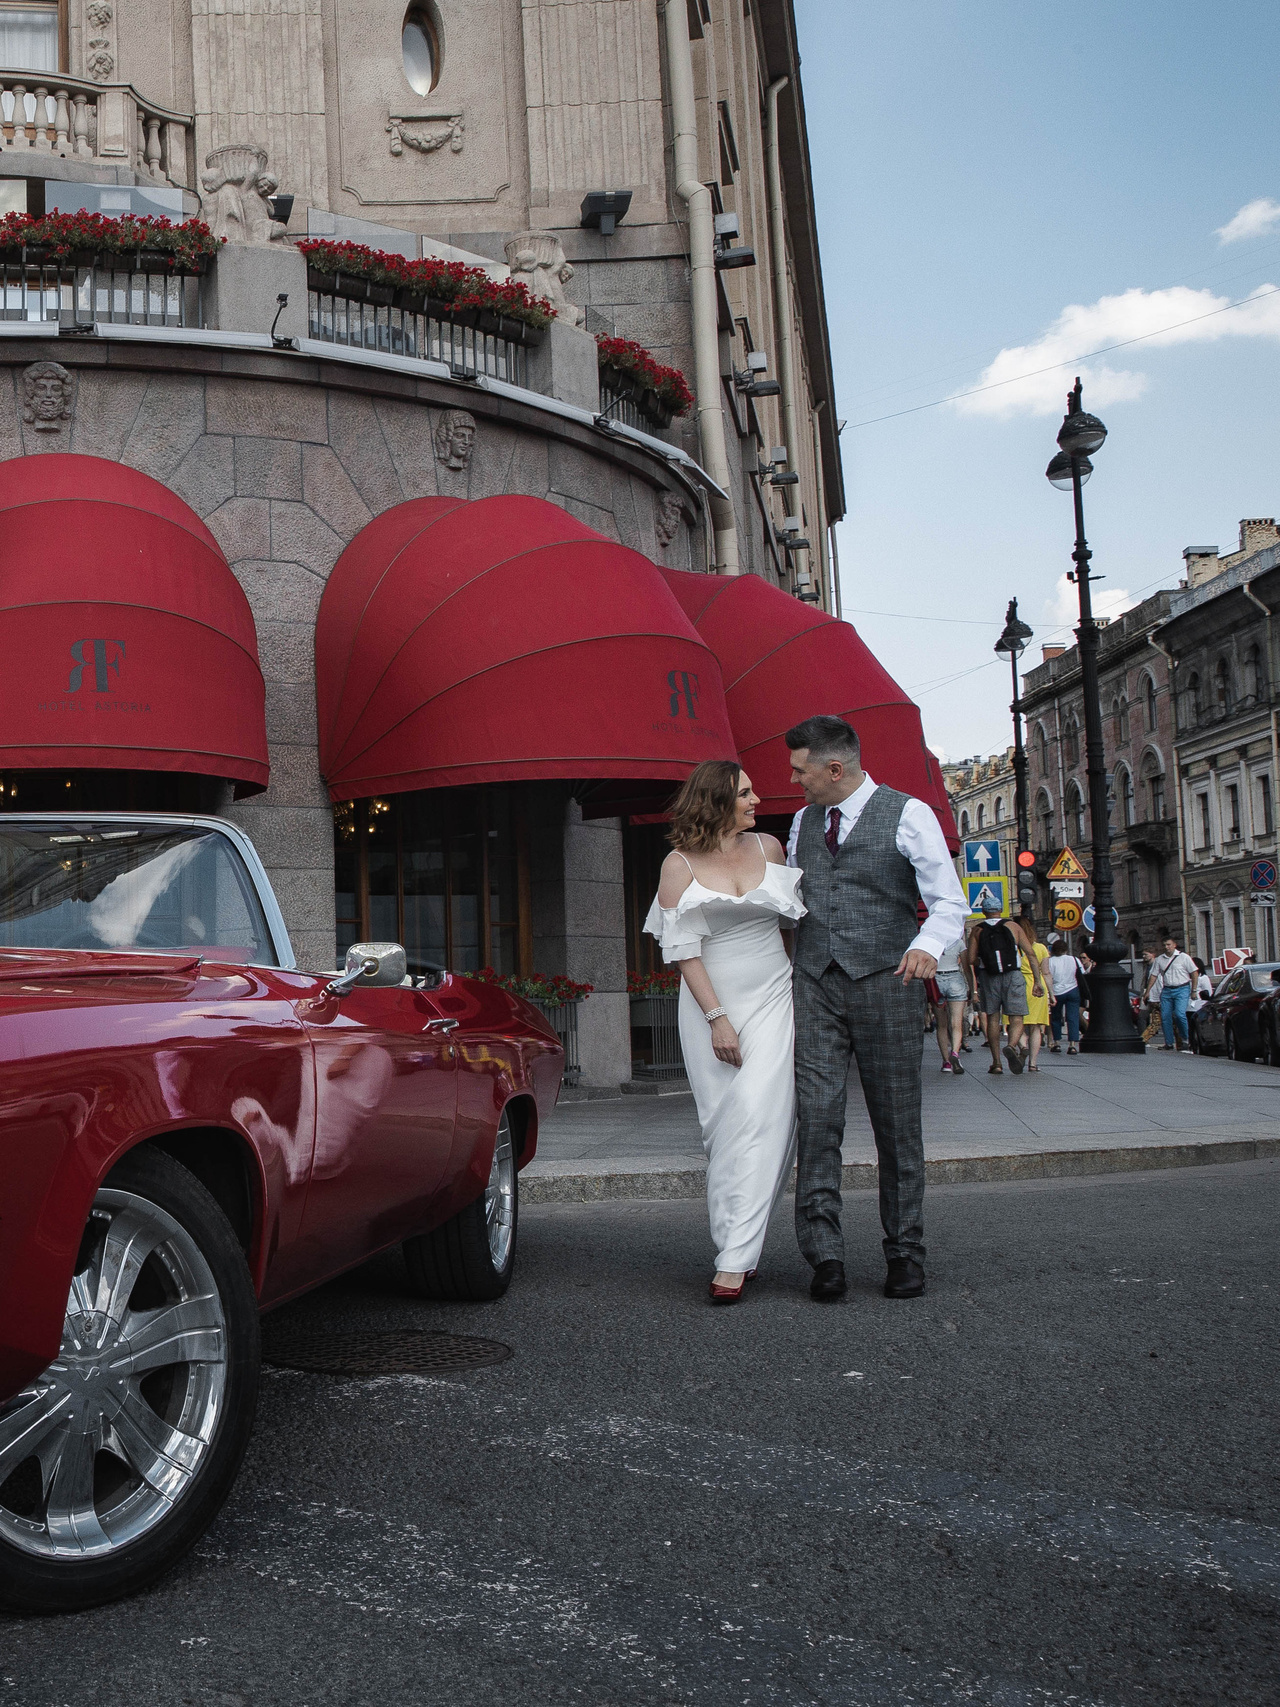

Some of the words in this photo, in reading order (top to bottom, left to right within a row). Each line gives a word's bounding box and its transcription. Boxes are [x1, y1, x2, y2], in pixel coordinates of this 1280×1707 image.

[38, 701, 85, 712] HOTEL
[94, 701, 152, 713] ASTORIA
[1057, 909, 1076, 922] 40
